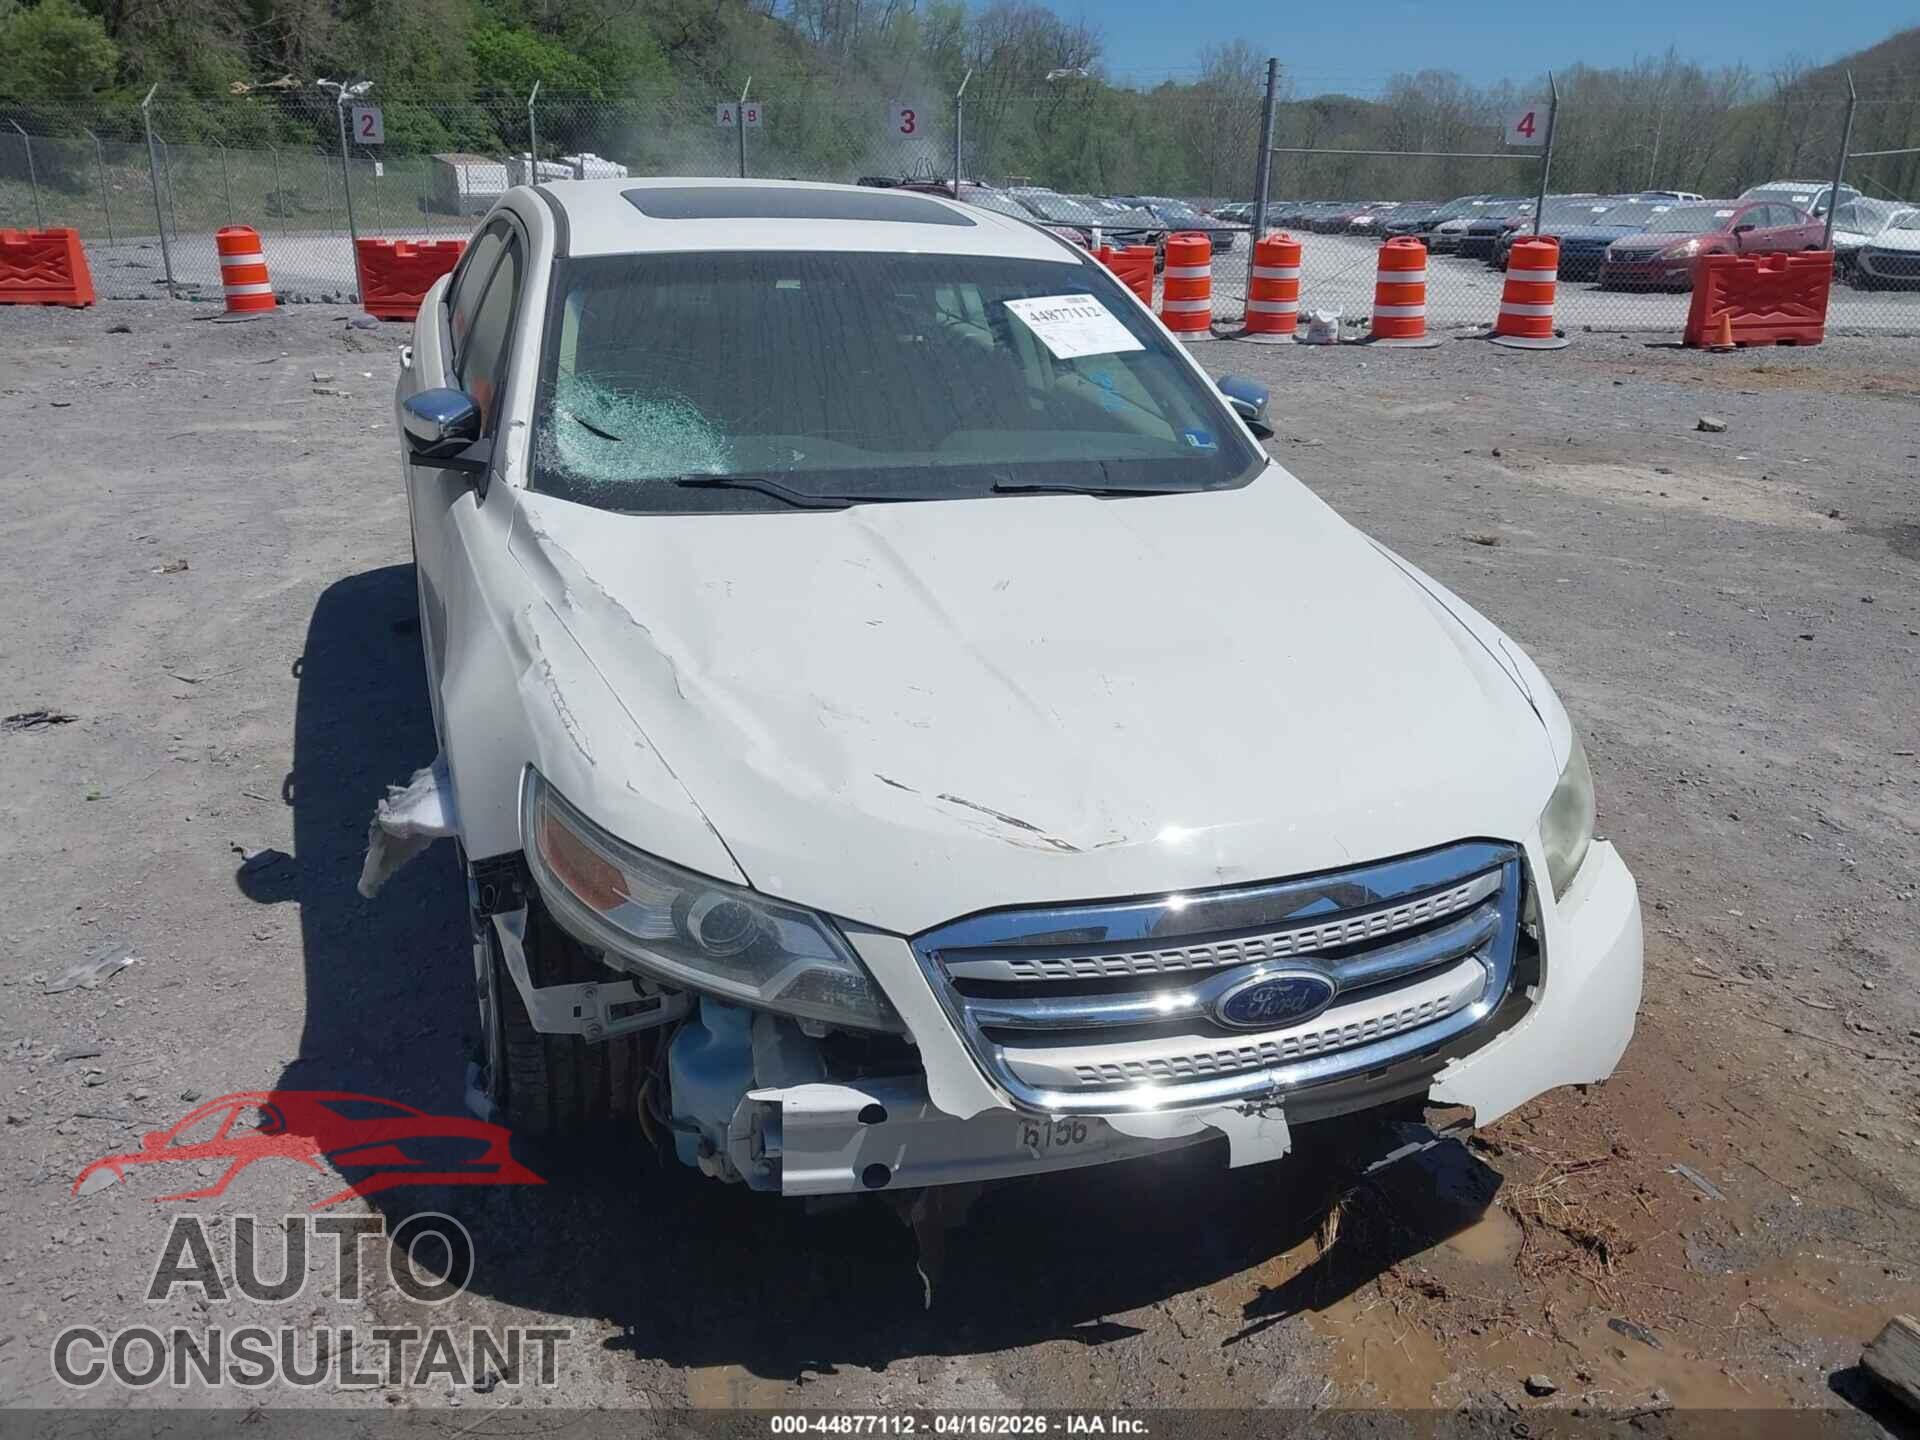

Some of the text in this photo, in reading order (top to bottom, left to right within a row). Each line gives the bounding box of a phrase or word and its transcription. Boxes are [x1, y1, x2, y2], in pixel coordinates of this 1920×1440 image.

[361, 114, 376, 137] 2
[722, 110, 731, 122] A
[747, 110, 757, 122] B
[900, 109, 915, 134] 3
[1517, 112, 1536, 138] 4
[1029, 306, 1102, 322] 44877112
[1248, 984, 1311, 1017] Ford
